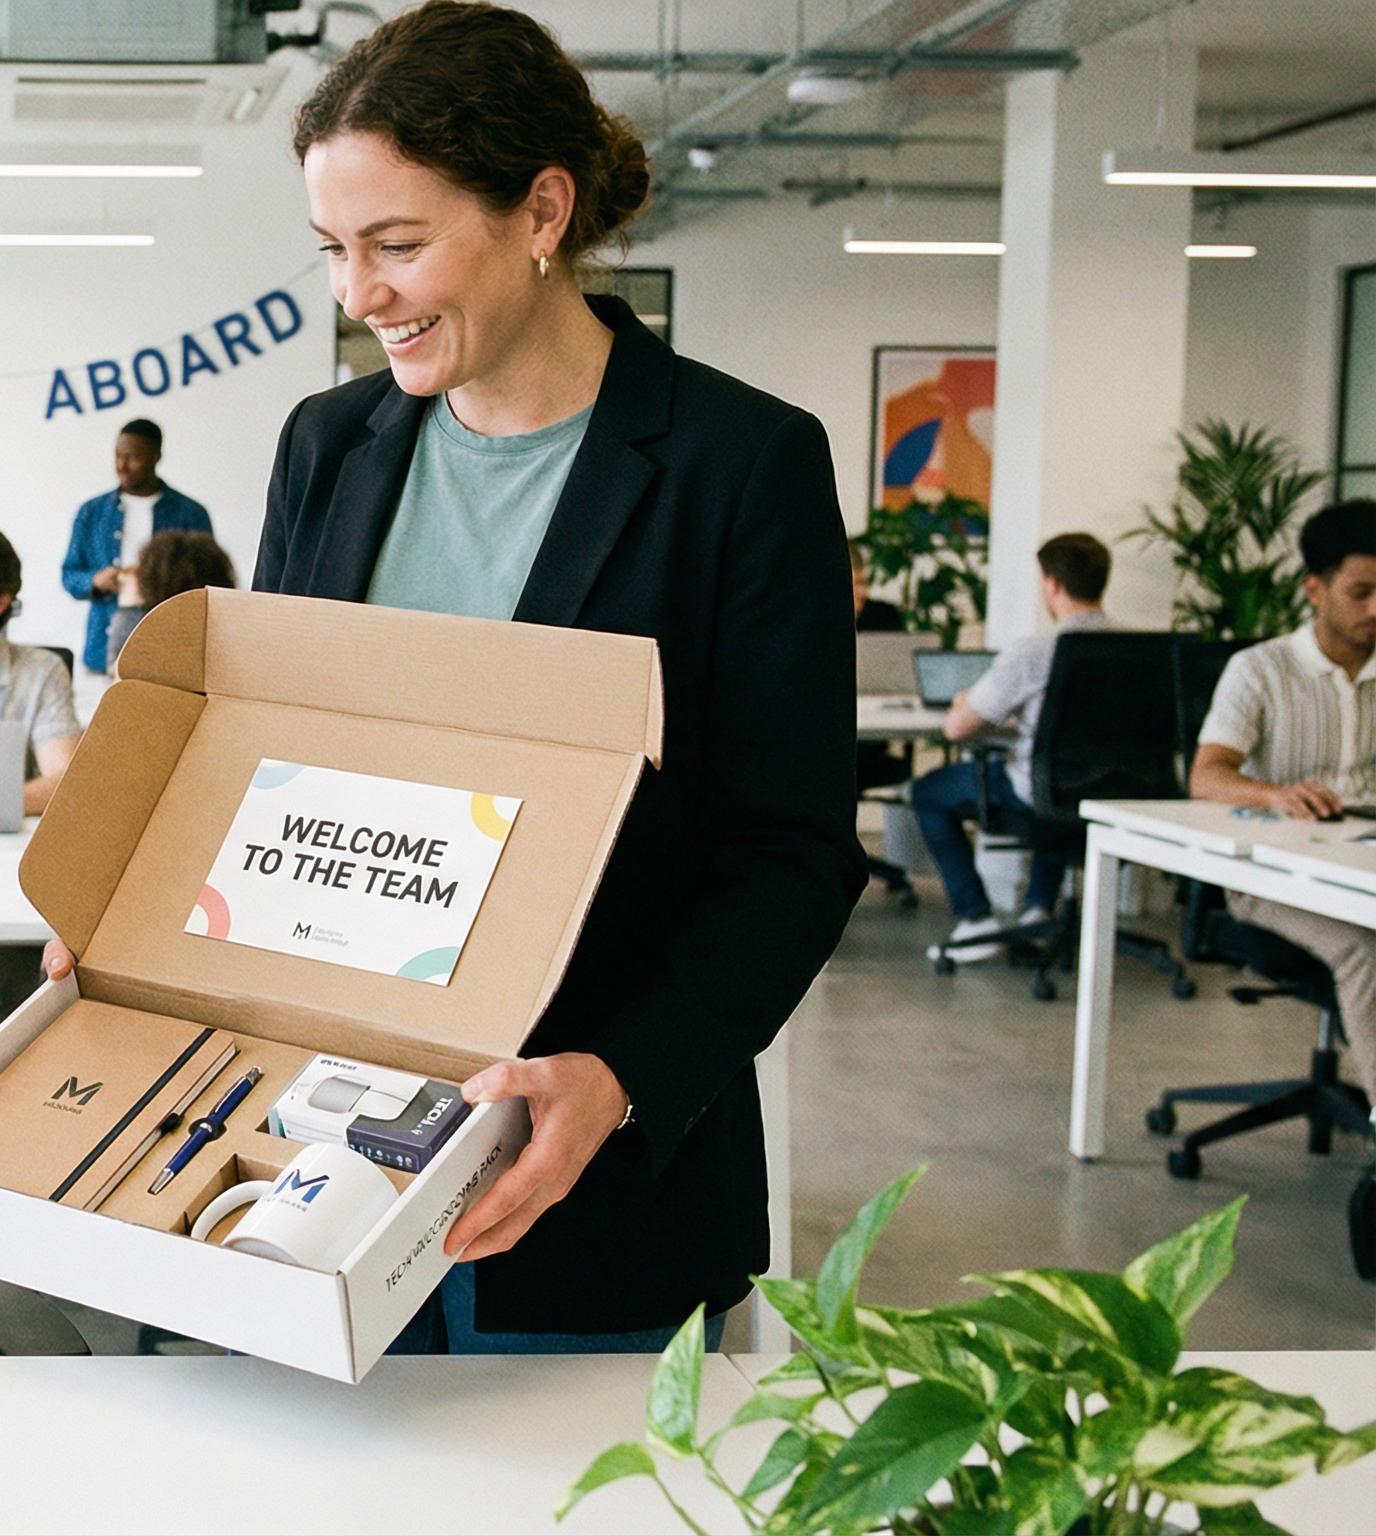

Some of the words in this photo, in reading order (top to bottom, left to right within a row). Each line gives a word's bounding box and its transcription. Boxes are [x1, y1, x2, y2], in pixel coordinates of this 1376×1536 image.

[45, 290, 302, 419] ABOARD
[281, 814, 448, 867] WELCOME
[243, 844, 283, 875] TO
[292, 853, 357, 889] THE
[364, 866, 459, 908] TEAM
